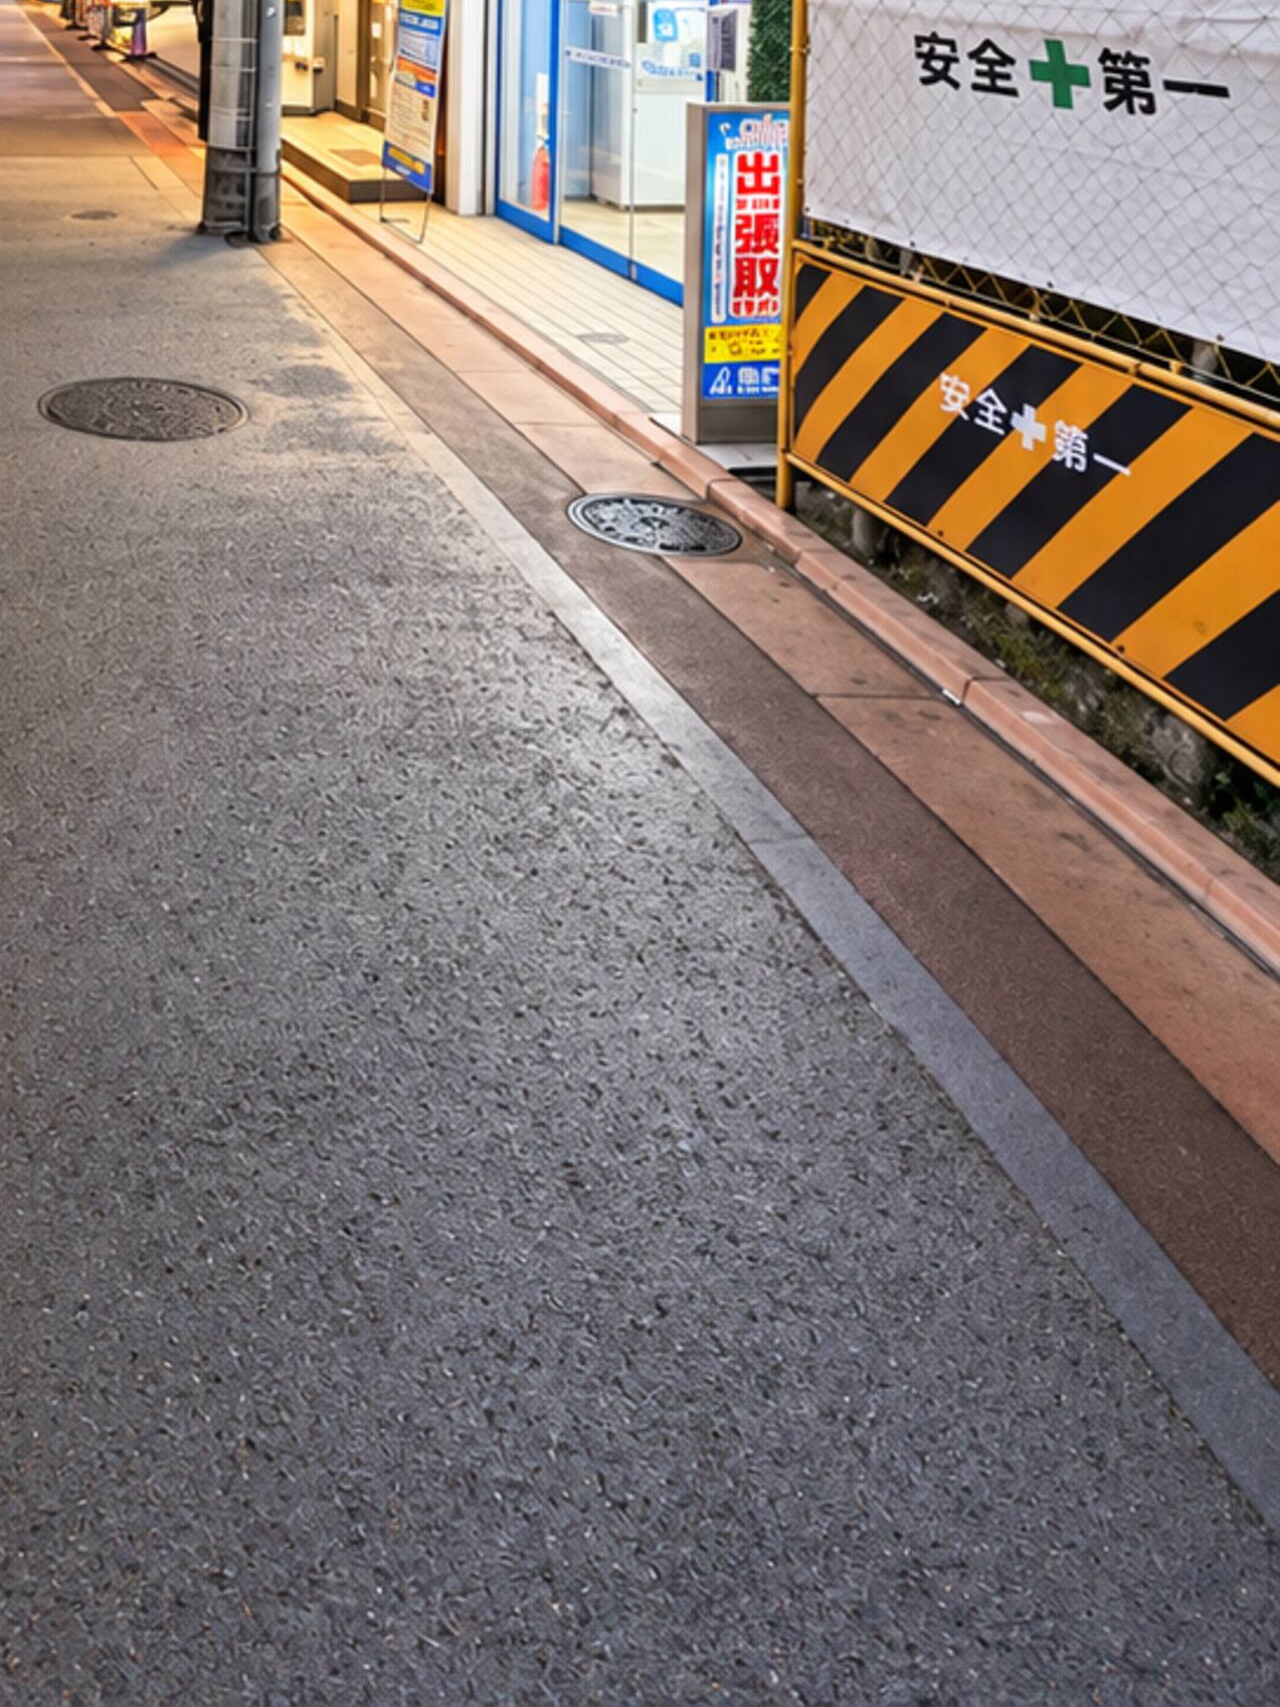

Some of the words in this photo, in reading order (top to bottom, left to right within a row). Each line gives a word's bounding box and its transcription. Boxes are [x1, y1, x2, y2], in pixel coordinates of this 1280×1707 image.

[913, 31, 1020, 98] 安全
[1097, 47, 1231, 116] 第一
[940, 372, 1008, 436] 安全
[1052, 419, 1132, 477] 第一
